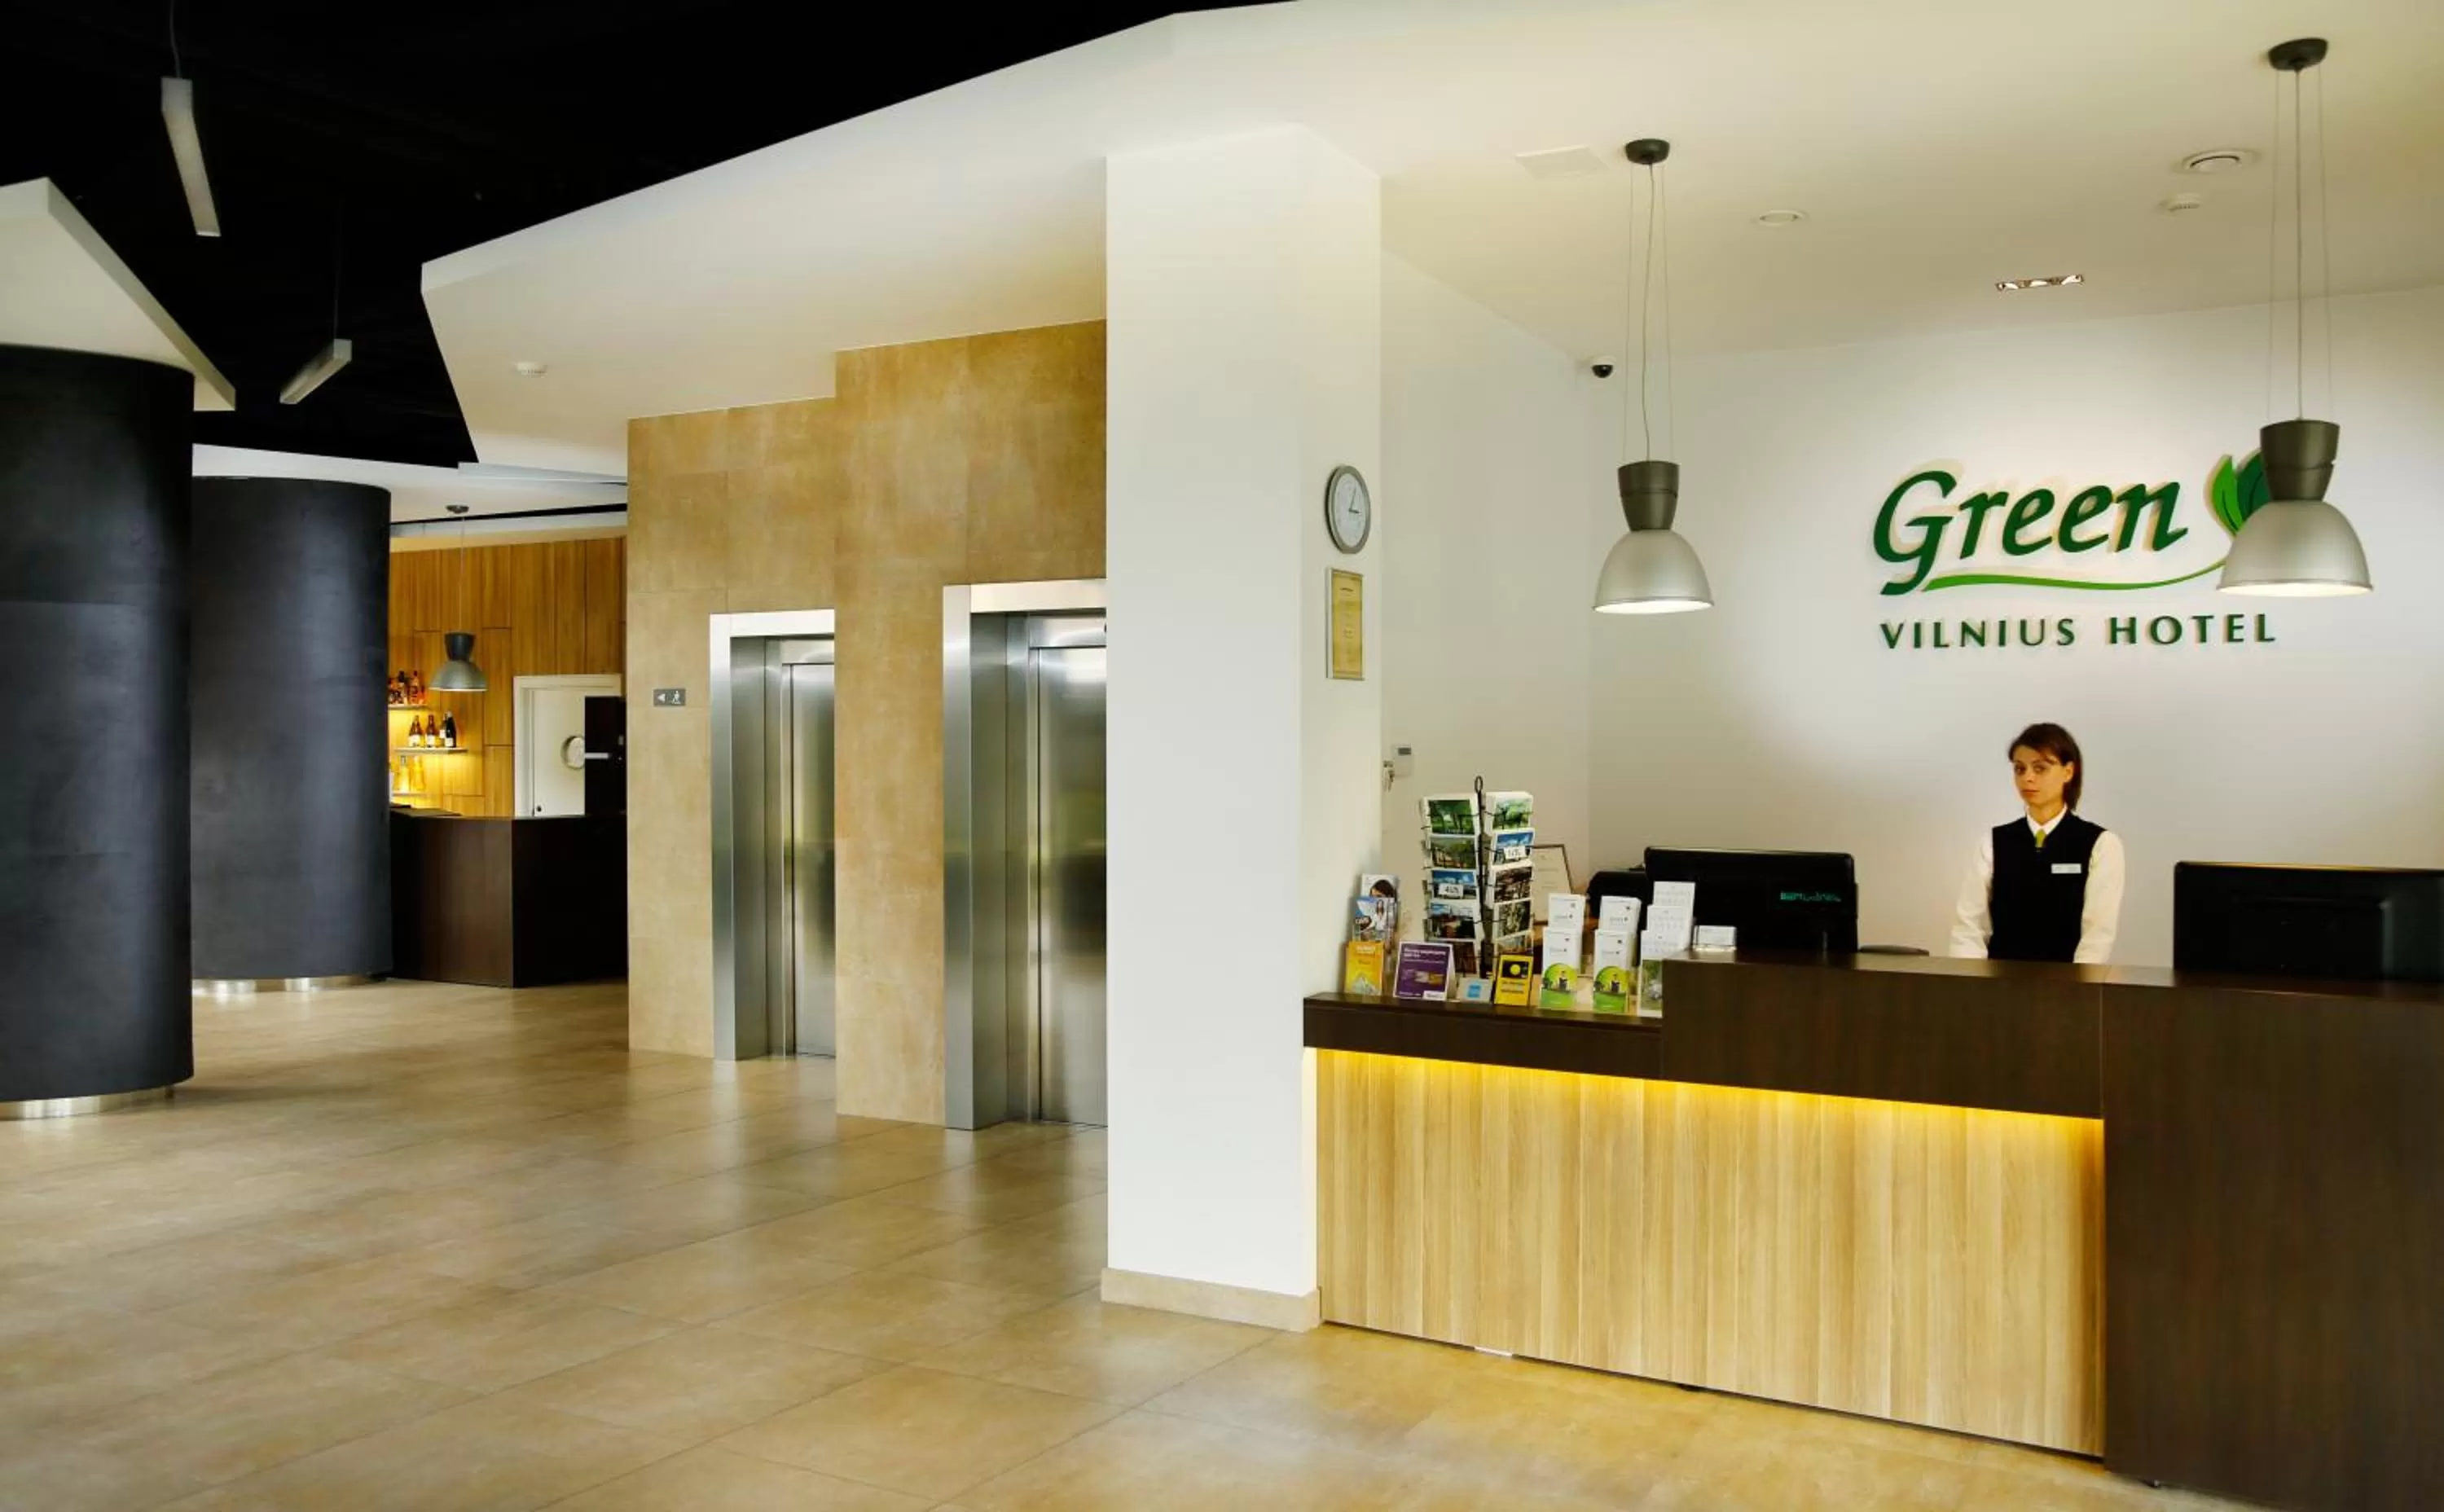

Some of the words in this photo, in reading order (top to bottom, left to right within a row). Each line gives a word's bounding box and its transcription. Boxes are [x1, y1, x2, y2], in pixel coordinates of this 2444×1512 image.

[1873, 470, 2189, 596] Green
[1879, 618, 2076, 649] VILNIUS
[2108, 613, 2276, 645] HOTEL
